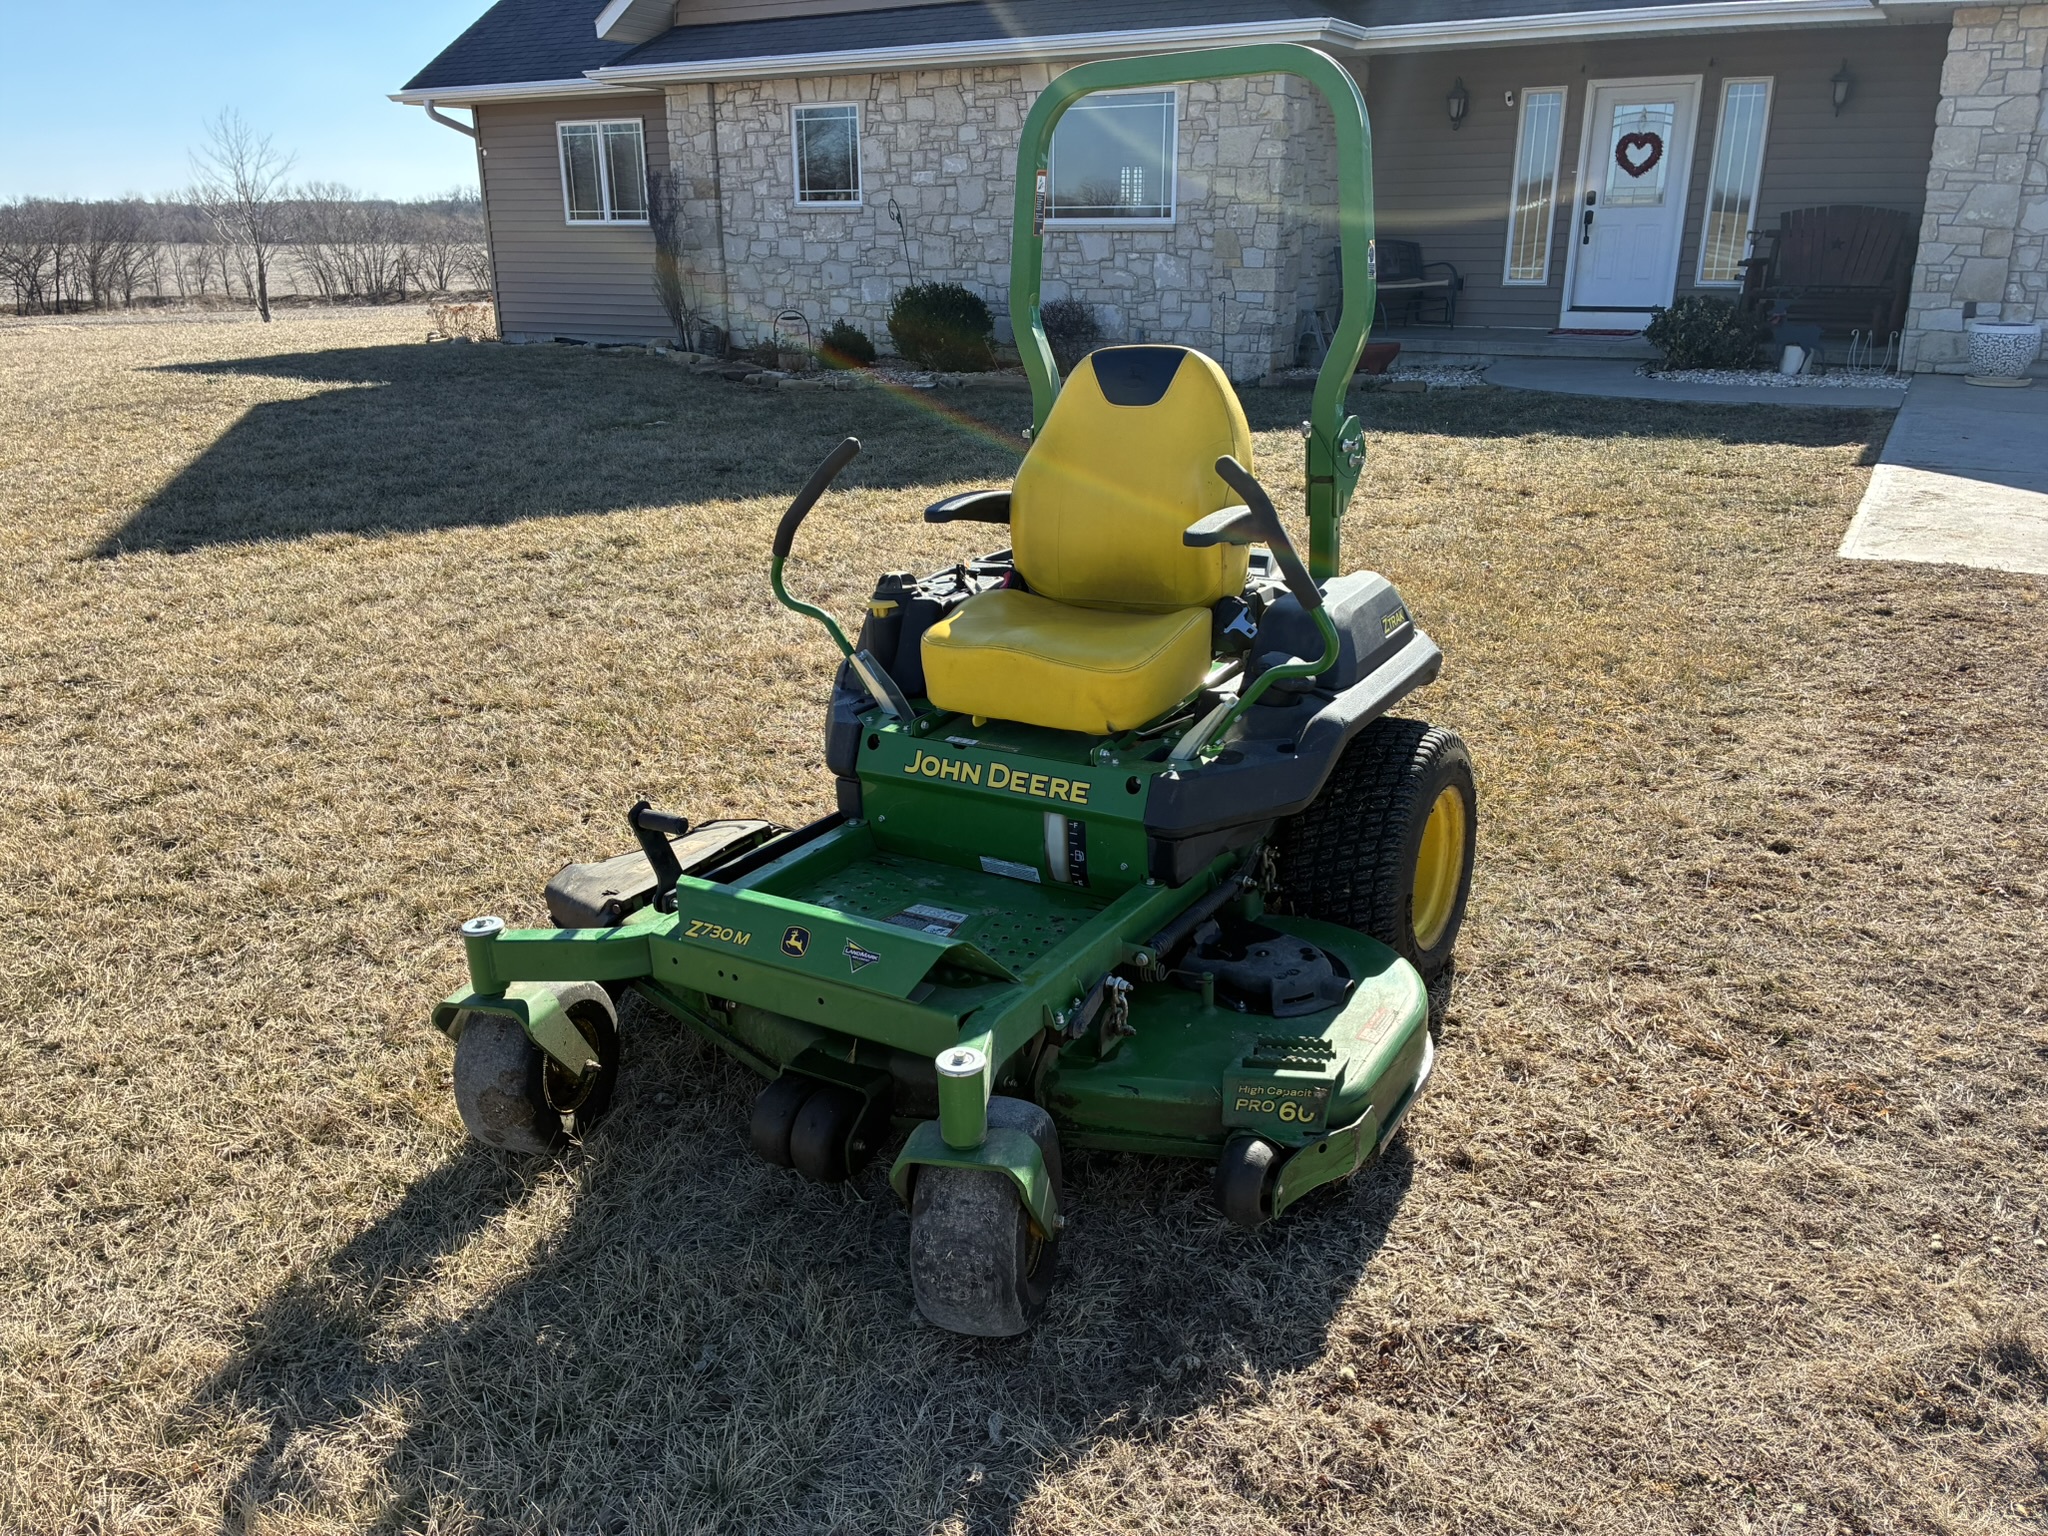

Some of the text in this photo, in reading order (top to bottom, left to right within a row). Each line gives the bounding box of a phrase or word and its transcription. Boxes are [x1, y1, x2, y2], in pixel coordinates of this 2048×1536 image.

[904, 749, 1091, 804] JOHN DEERE
[1238, 1085, 1317, 1098] High Capacit
[1235, 1098, 1275, 1112] PRO
